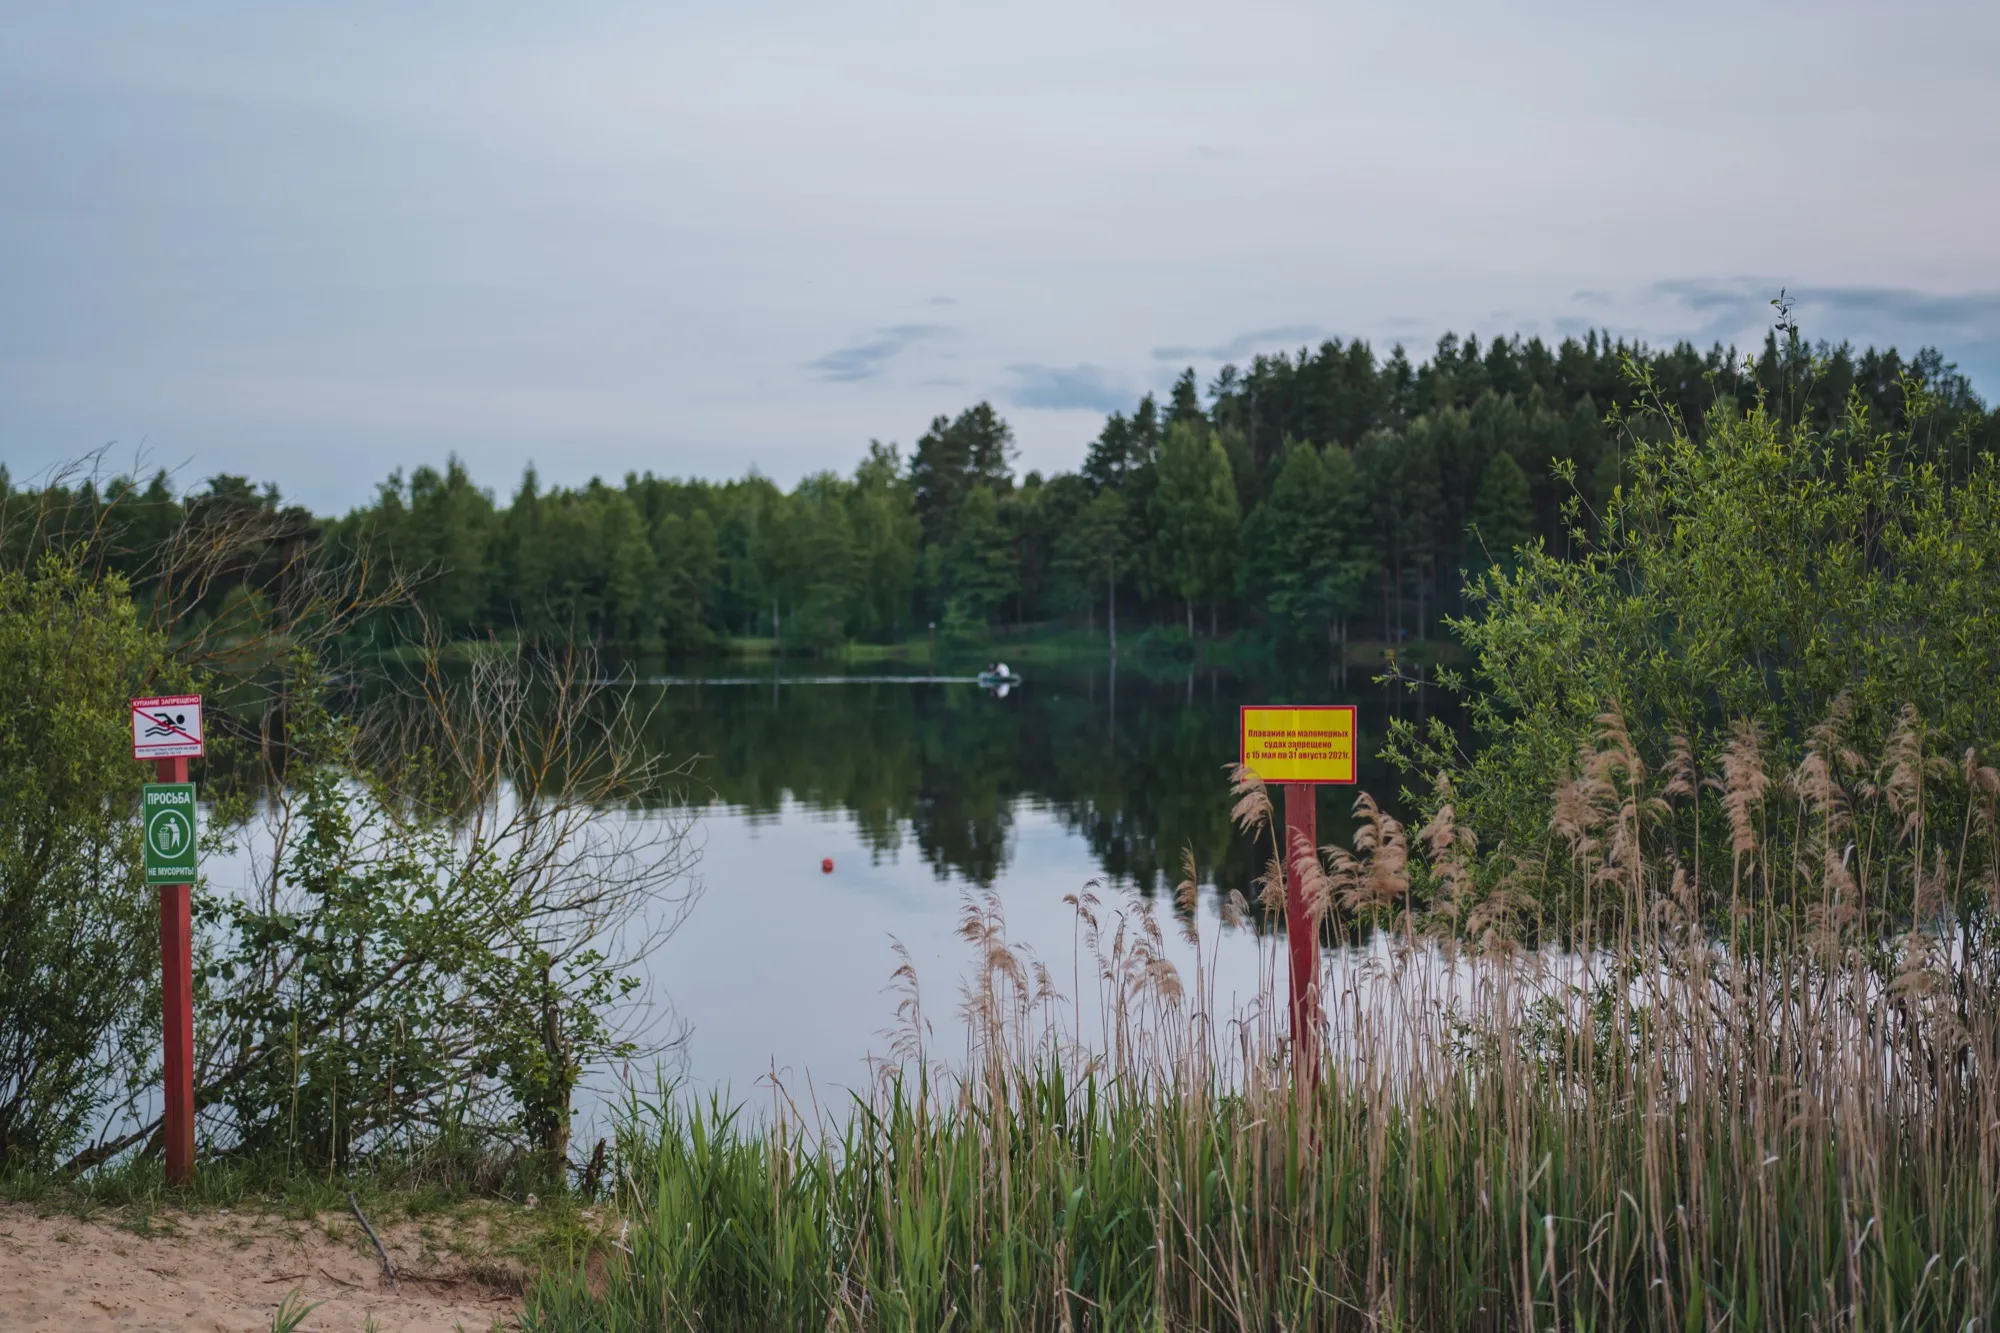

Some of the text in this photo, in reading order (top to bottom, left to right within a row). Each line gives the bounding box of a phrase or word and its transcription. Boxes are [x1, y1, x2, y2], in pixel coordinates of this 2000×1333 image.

[161, 697, 199, 705] ЗАПРЕЩЕНО
[1287, 730, 1296, 738] на
[1298, 730, 1348, 738] маломерных
[1264, 741, 1332, 749] судах запрещено
[1298, 752, 1327, 760] августа
[147, 792, 190, 805] ПРОСЬБА
[148, 867, 194, 876] НЕ МУСОРИТЬ!
